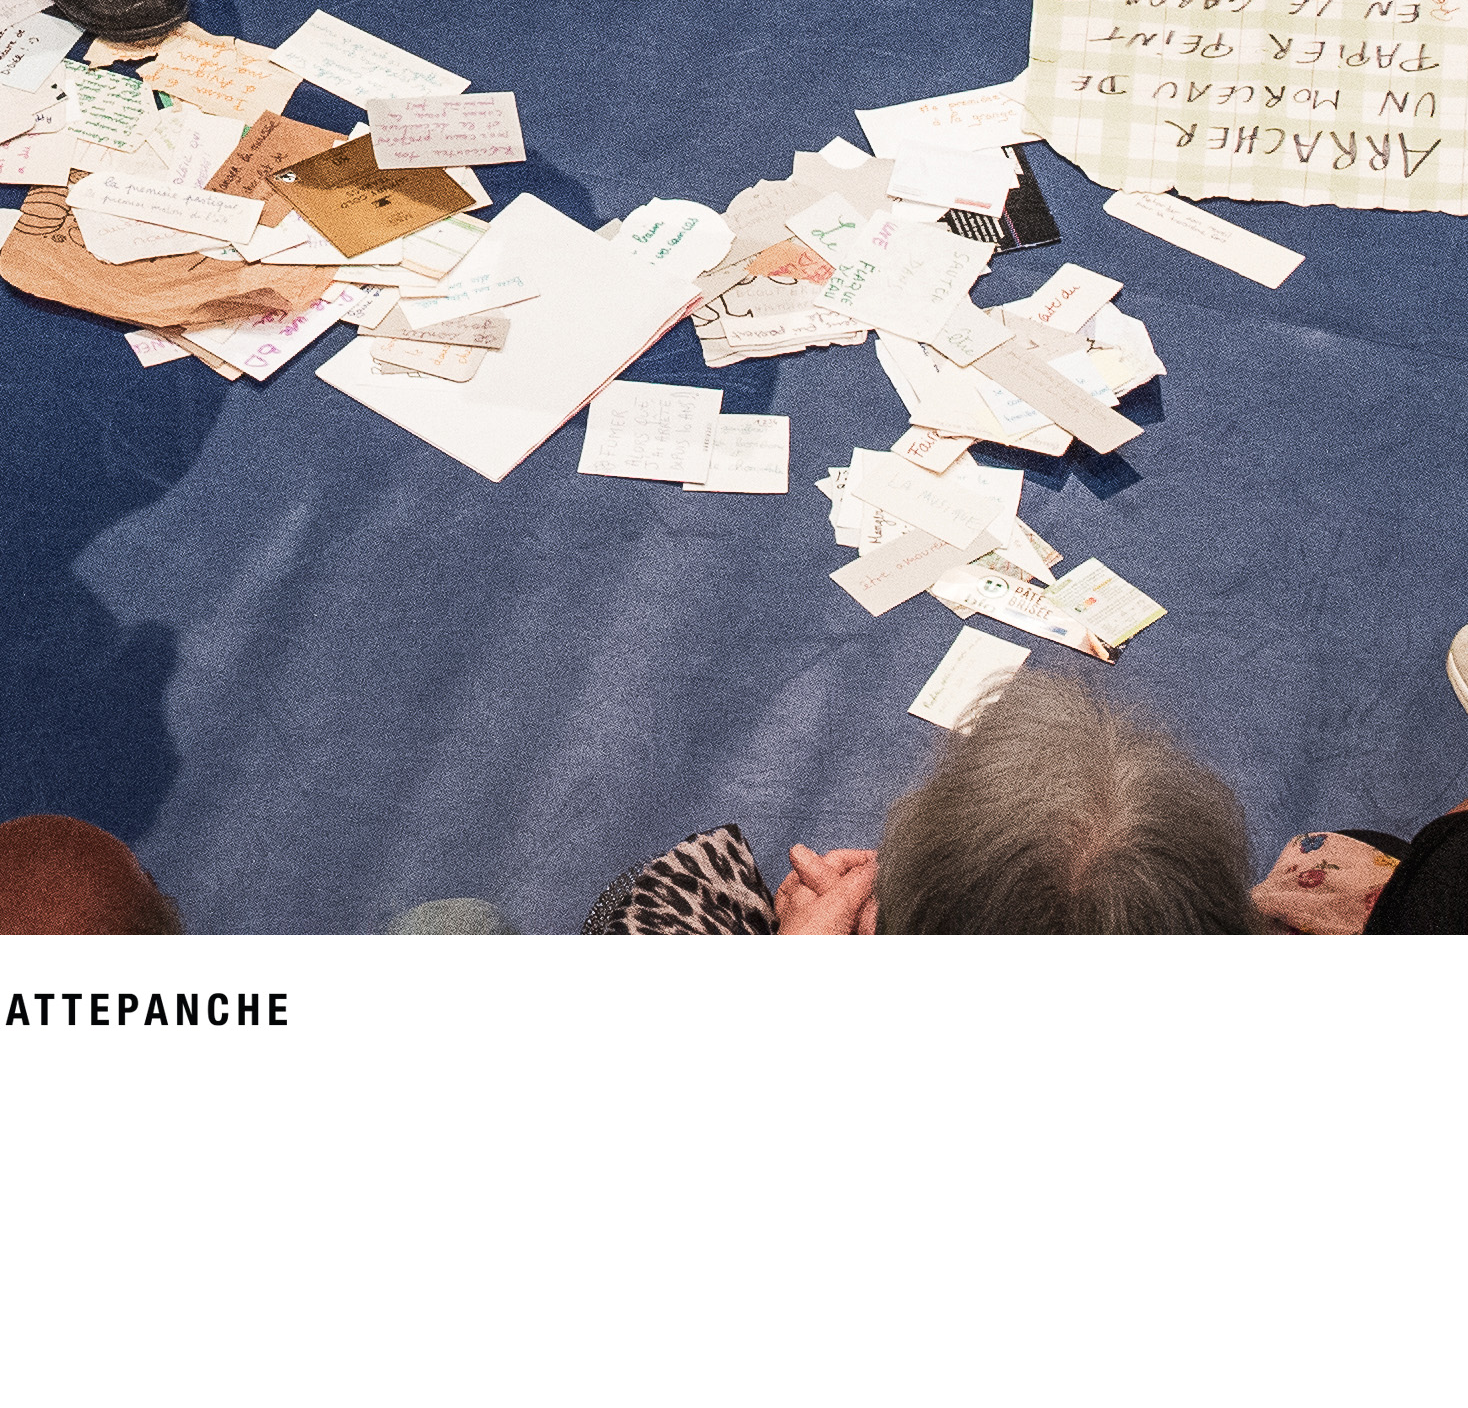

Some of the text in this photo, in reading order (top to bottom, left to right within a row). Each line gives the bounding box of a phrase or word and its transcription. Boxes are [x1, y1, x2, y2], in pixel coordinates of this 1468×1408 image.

[1363, 0, 1421, 24] EN
[1077, 74, 1437, 119] UN MORCEAU DE
[1164, 119, 1442, 179] ARRACHER
